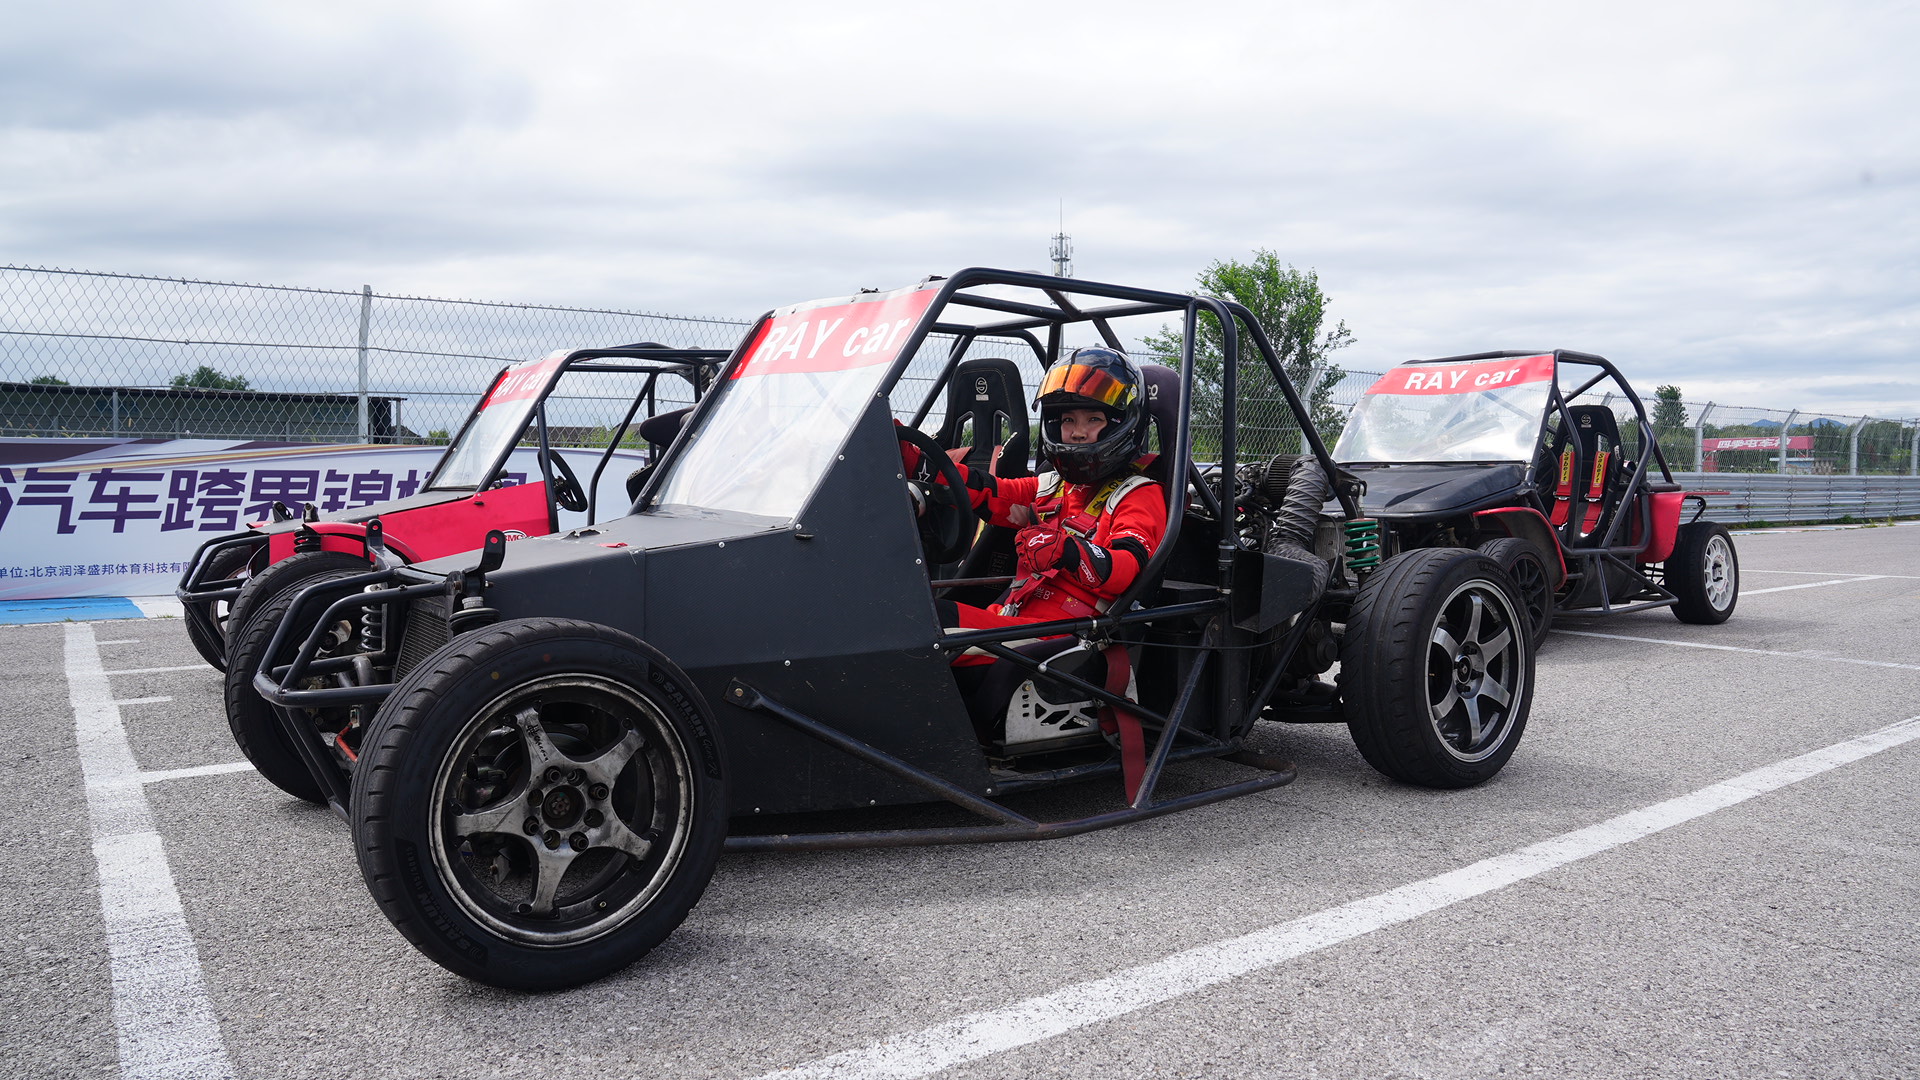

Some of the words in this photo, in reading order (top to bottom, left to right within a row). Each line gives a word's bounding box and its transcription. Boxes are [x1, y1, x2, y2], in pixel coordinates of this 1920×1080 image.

[752, 317, 845, 365] RAY
[842, 317, 912, 359] car
[490, 370, 531, 400] RAY
[520, 370, 553, 392] car
[1404, 369, 1468, 390] RAY
[1474, 368, 1520, 387] car
[0, 467, 527, 535] 汽车跨界锦
[662, 681, 707, 738] SAILUN
